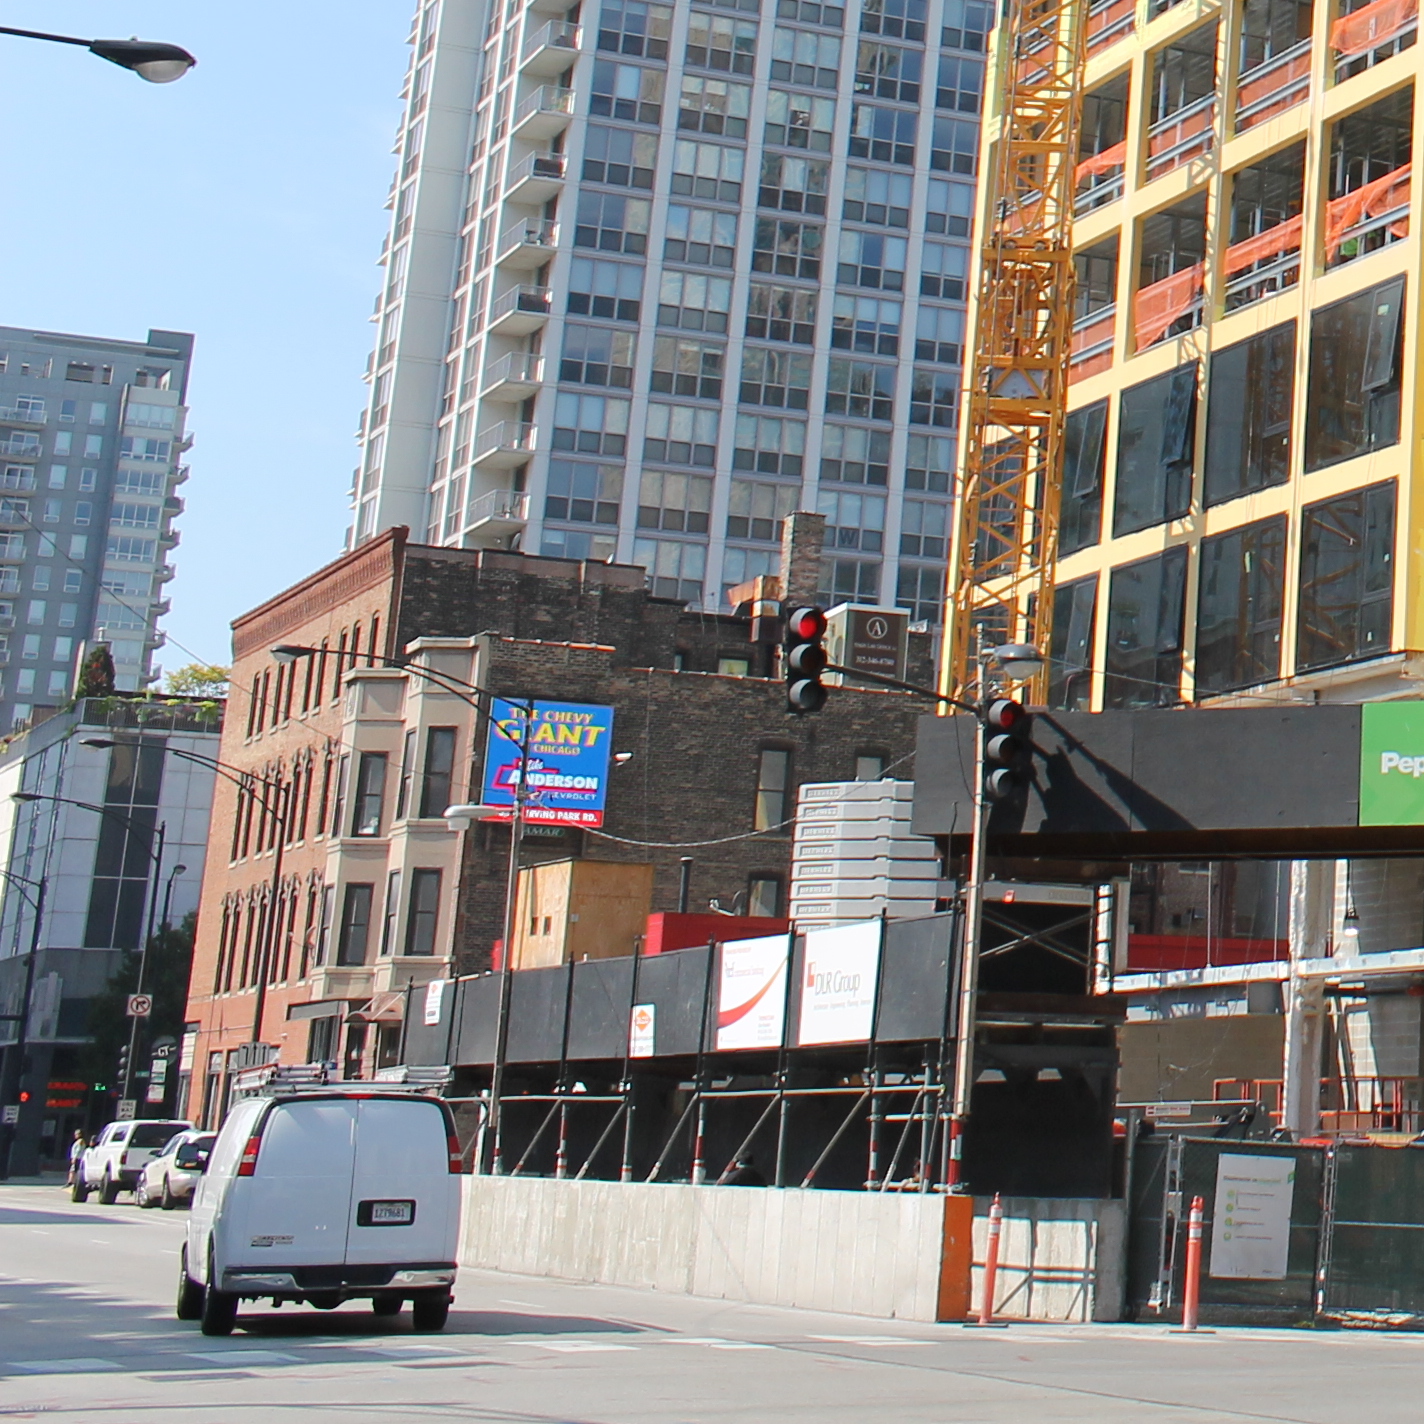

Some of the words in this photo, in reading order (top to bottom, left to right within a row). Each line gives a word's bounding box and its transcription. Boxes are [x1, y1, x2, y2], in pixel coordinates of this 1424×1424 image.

[542, 709, 594, 725] CHEVY
[494, 719, 606, 747] GANT
[534, 743, 581, 756] CHICAGO
[507, 769, 599, 790] ANDERSON
[525, 809, 556, 820] IRVING
[557, 810, 580, 822] PARK
[582, 812, 598, 823] RD.
[523, 827, 561, 837] AMAR
[814, 973, 833, 995] DLR
[833, 970, 861, 997] Group
